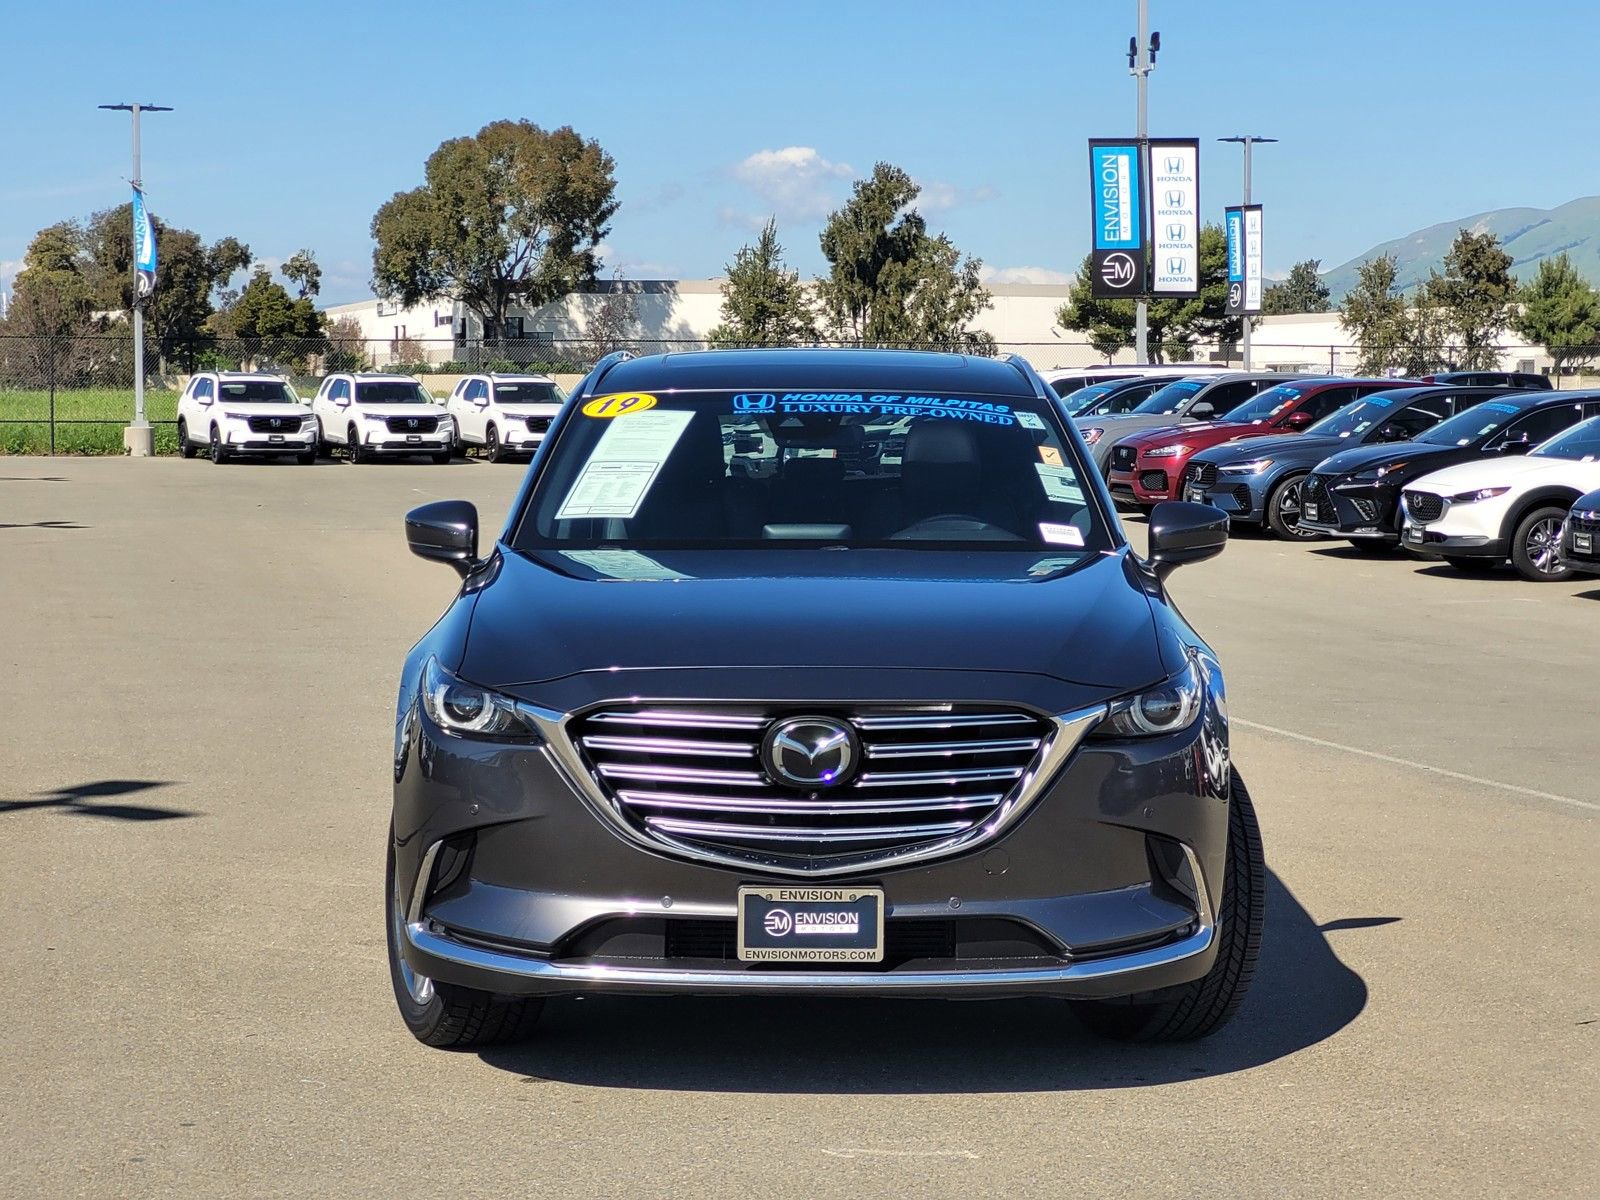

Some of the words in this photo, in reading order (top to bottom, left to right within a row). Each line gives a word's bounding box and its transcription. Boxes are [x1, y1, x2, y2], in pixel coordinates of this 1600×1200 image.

[1102, 154, 1120, 242] ENVISION
[598, 397, 640, 413] 19
[782, 393, 863, 402] HONDA
[869, 394, 901, 402] OF
[904, 396, 1010, 413] MILPITAS
[783, 404, 875, 414] LUXURY
[880, 405, 1013, 426] PRE-OWNED
[779, 890, 843, 900] ENVISION
[795, 912, 859, 925] ENVISION
[745, 950, 876, 960] ENVISIONMOTORS.COM
